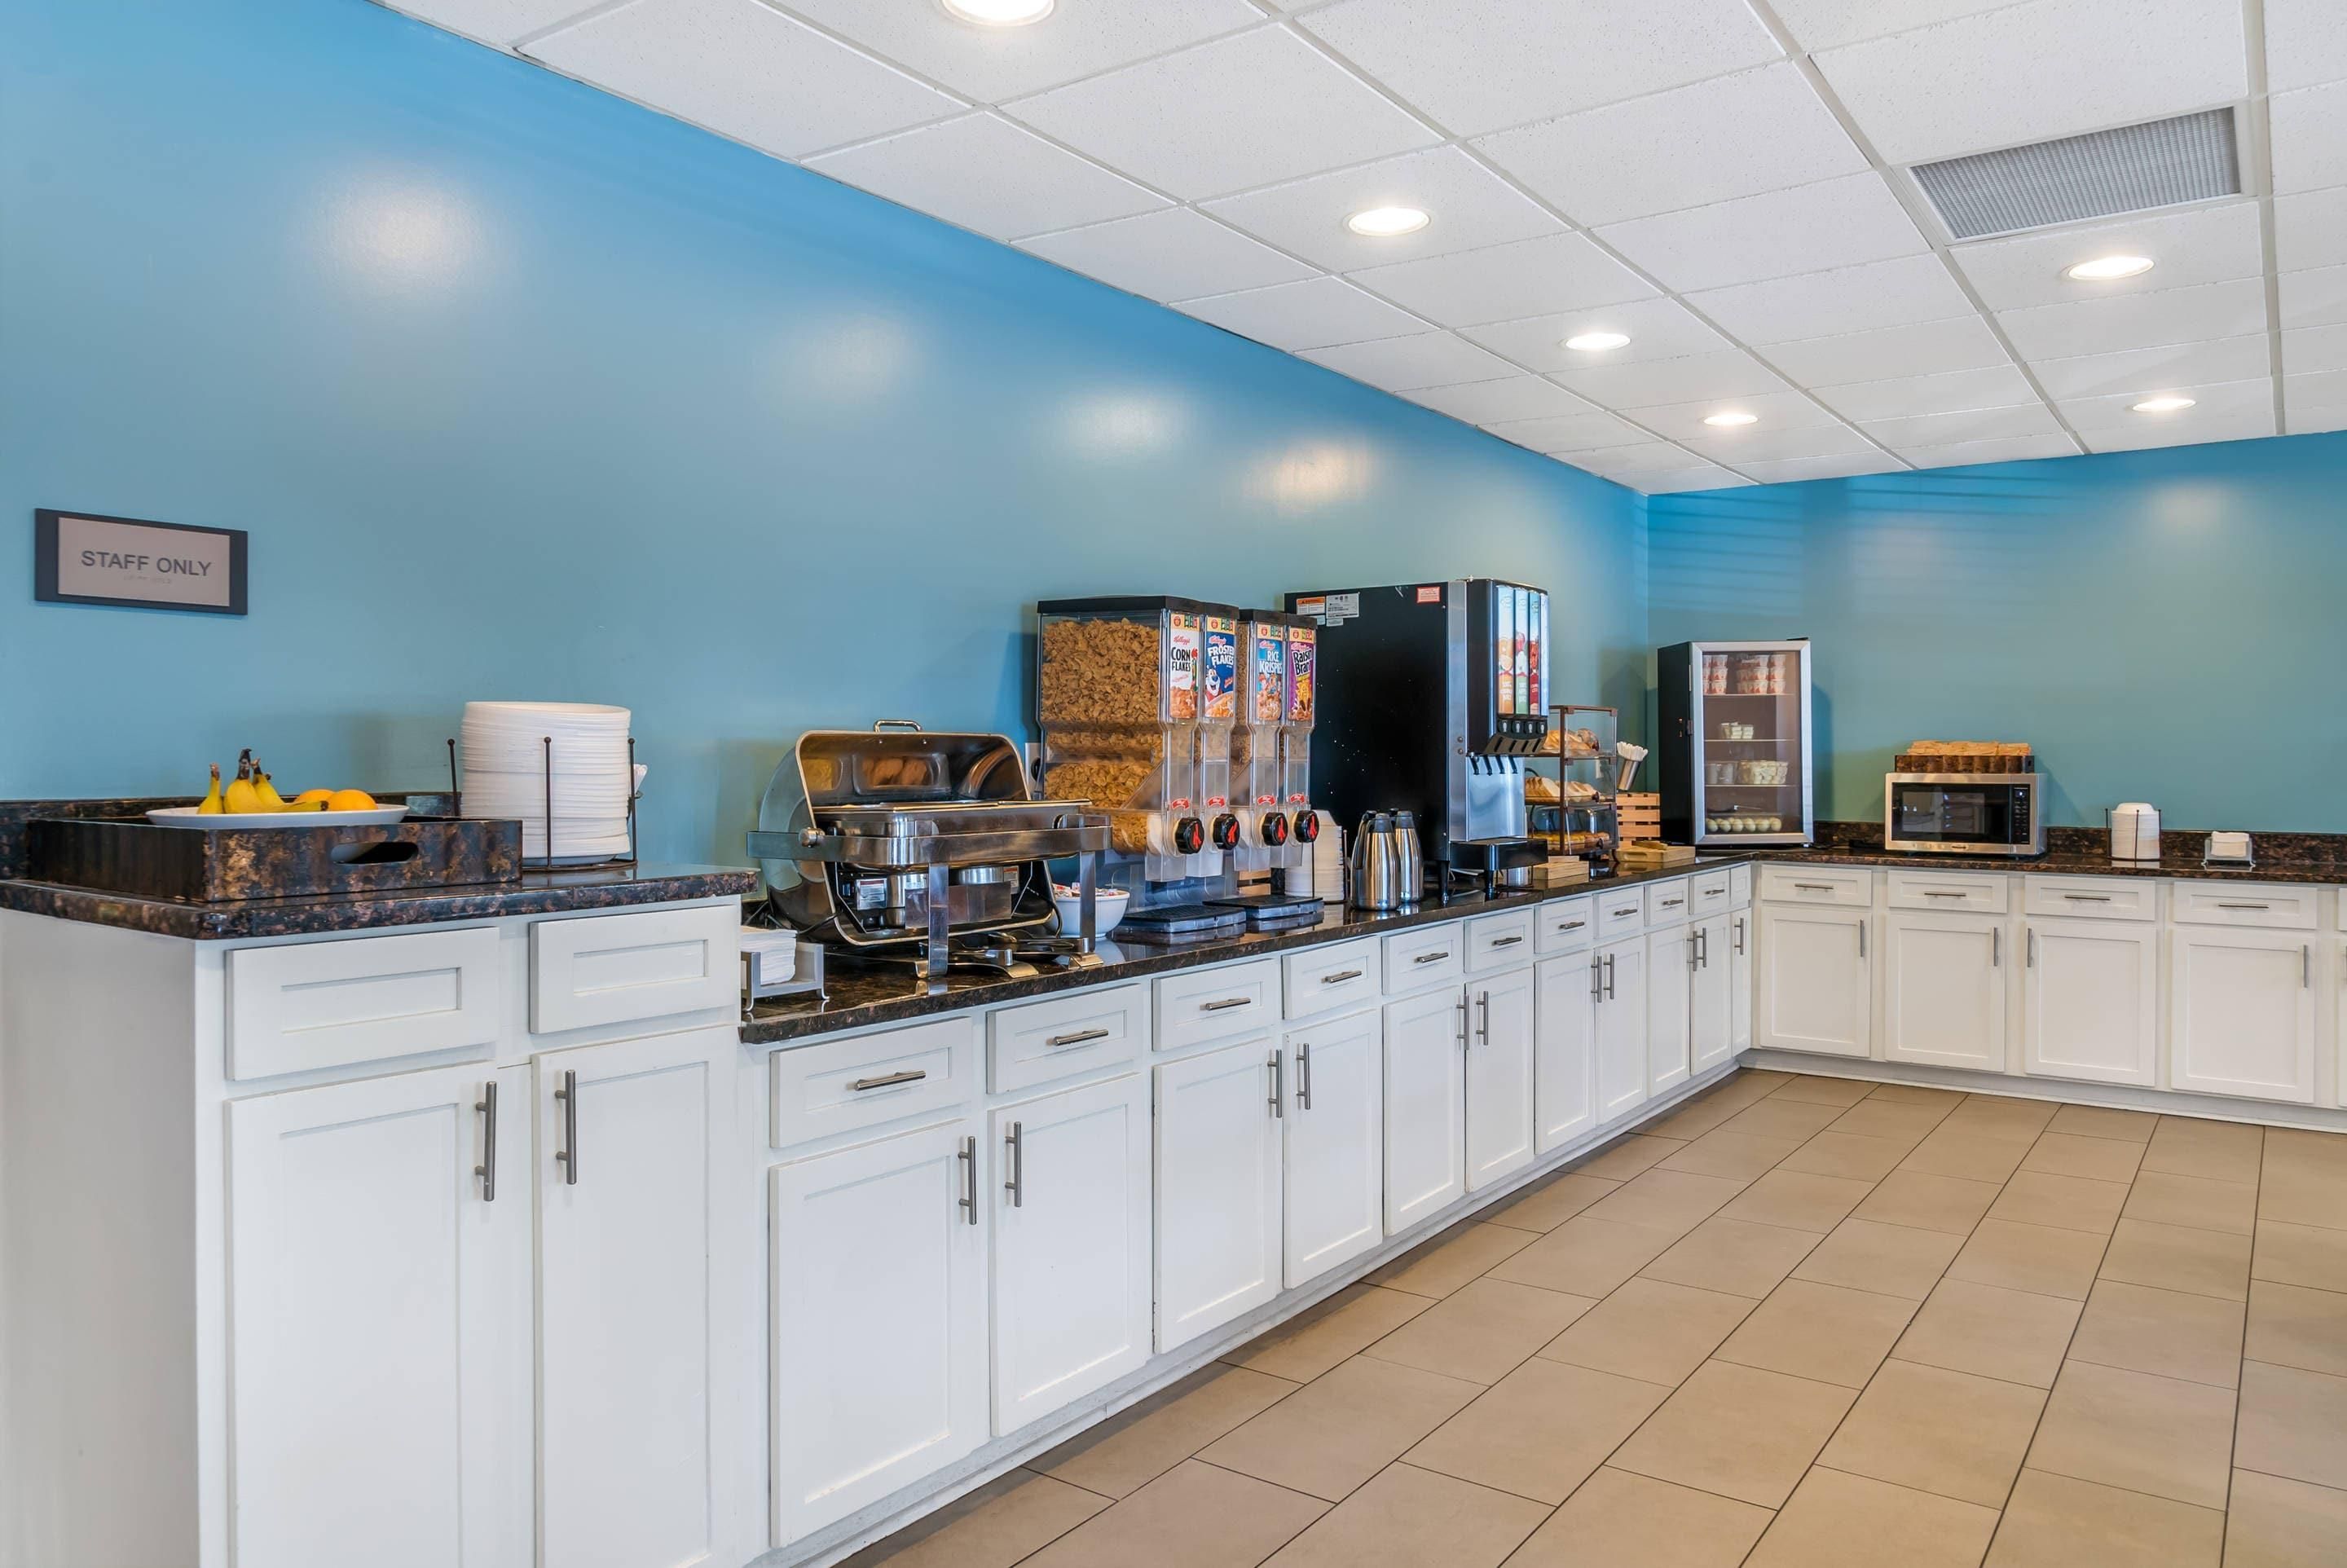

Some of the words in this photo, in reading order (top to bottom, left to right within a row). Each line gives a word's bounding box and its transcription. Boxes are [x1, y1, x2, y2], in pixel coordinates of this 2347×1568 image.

[81, 550, 150, 570] STAFF
[156, 557, 212, 576] ONLY
[1172, 647, 1191, 661] CORN
[1212, 655, 1234, 665] FLAKES
[1267, 650, 1279, 662] RICE
[1172, 662, 1191, 672] FLAKES
